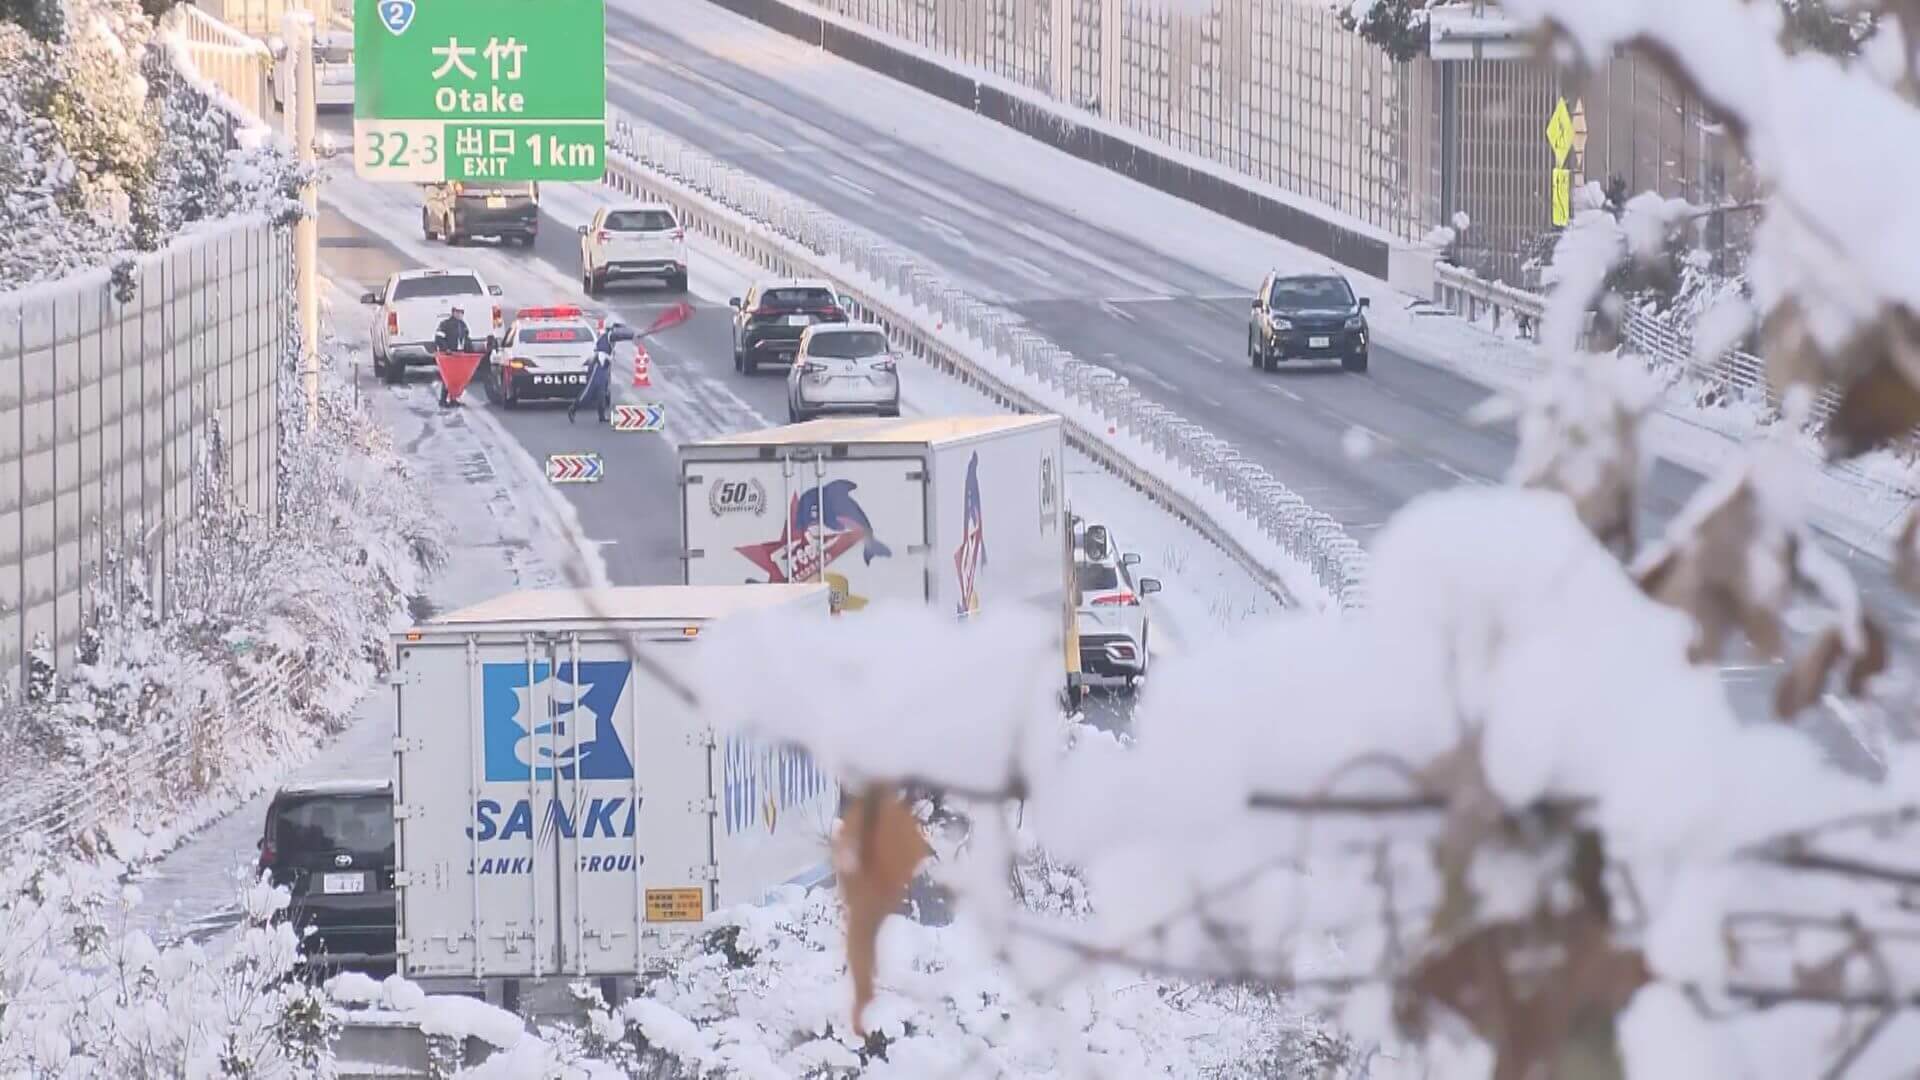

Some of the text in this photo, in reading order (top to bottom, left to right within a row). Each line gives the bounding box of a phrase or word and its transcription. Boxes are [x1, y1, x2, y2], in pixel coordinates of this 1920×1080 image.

[389, 3, 405, 25] 2
[431, 37, 528, 81] 大竹
[434, 86, 525, 113] Otake
[364, 131, 438, 168] 32-3
[455, 127, 516, 156] 出口
[463, 158, 508, 177] EXIT
[533, 375, 587, 385] POLICE
[465, 796, 643, 844] SANKI
